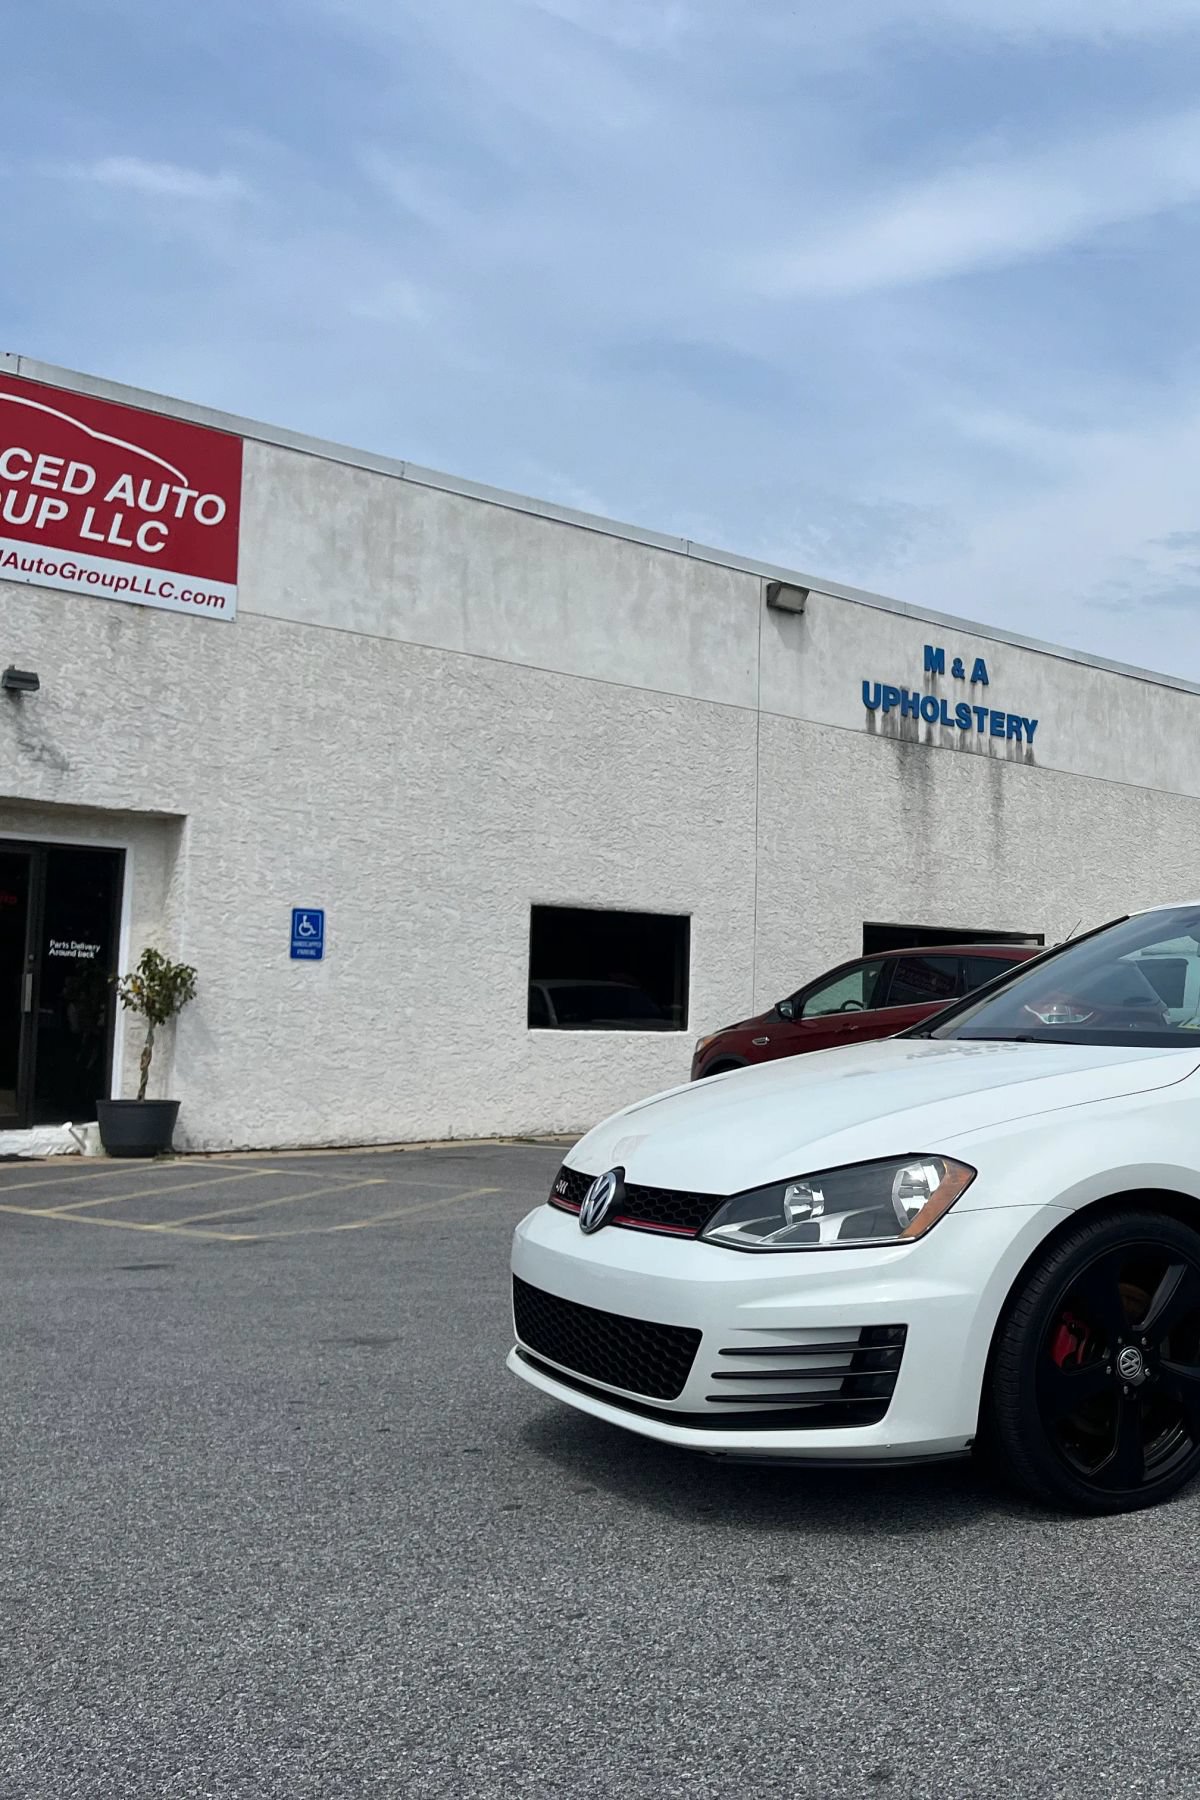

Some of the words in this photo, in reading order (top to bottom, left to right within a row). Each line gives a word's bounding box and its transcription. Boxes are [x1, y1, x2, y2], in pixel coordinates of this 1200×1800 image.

[0, 489, 69, 529] UP
[79, 506, 169, 553] LLC
[104, 473, 226, 526] AUTO
[0, 549, 225, 608] AutoGroupLLC.com
[924, 644, 945, 675] M
[951, 657, 965, 680] &
[970, 657, 989, 685] A
[862, 681, 1038, 743] UPHOLSTERY
